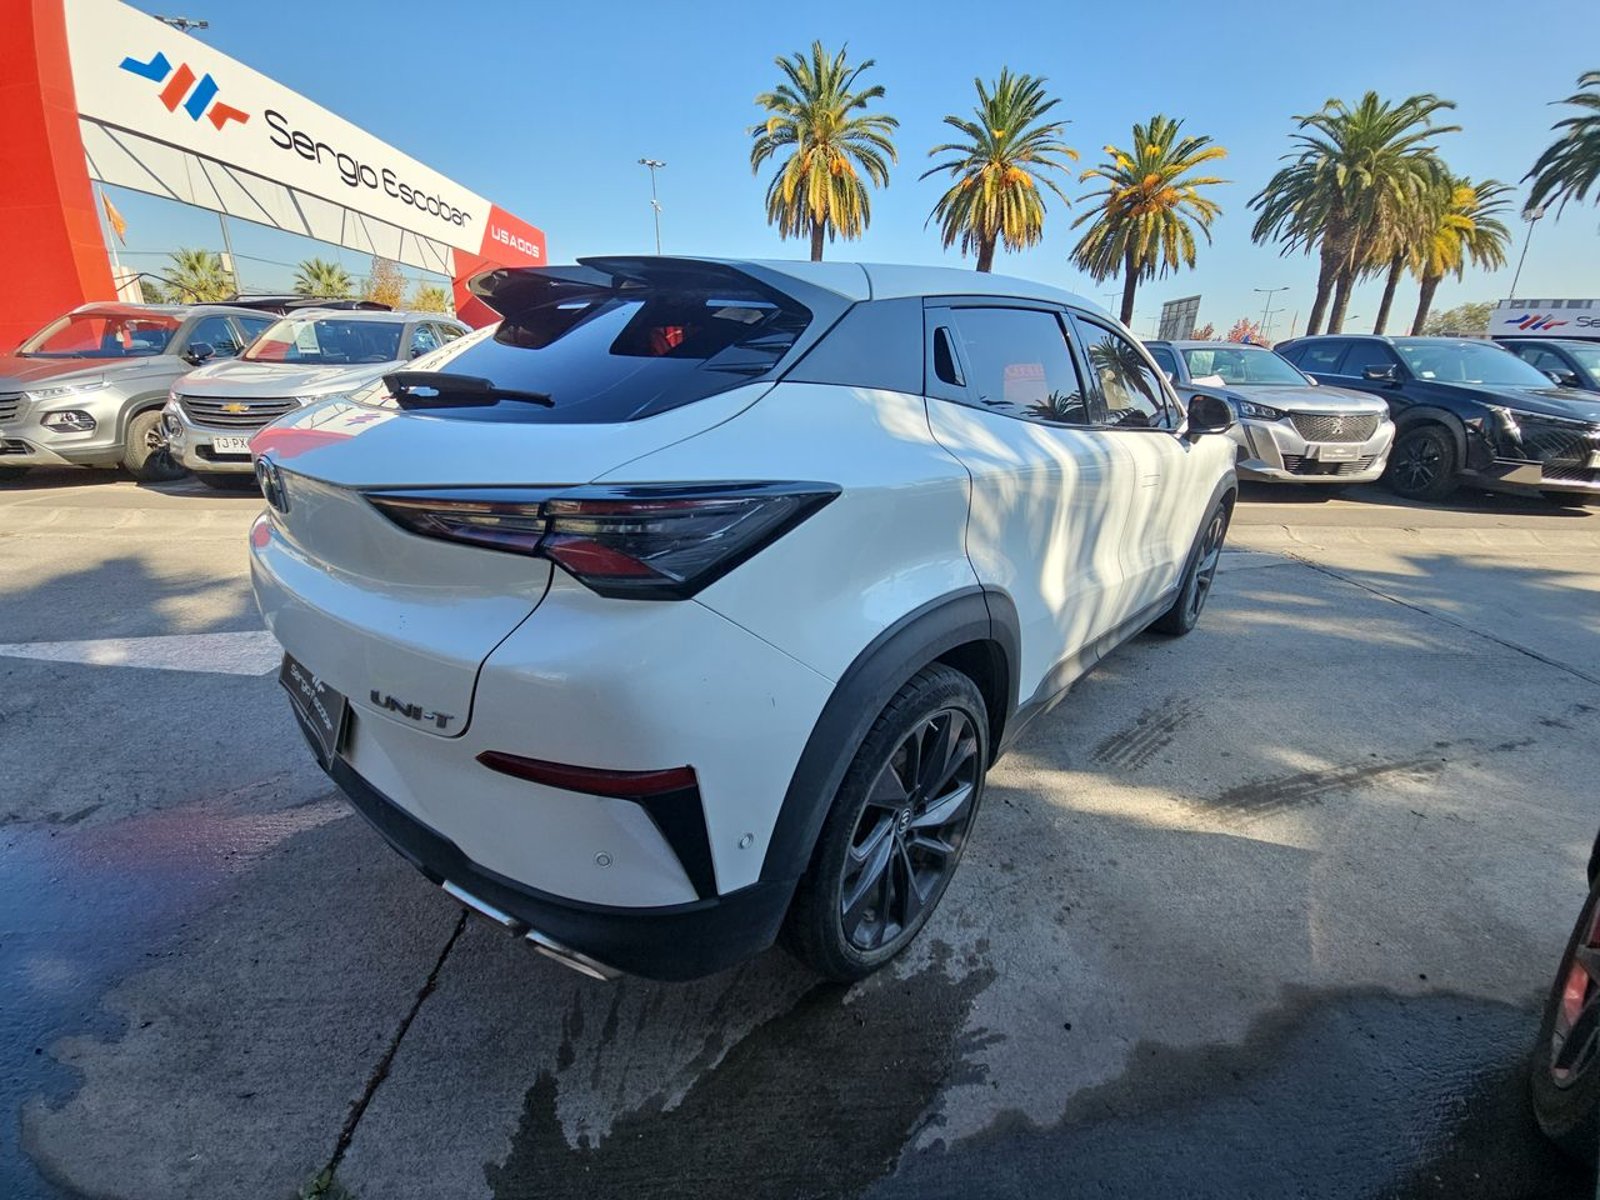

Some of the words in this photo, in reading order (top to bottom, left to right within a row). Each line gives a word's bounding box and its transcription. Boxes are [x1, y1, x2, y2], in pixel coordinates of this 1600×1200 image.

[264, 109, 378, 190] Sergio
[381, 168, 472, 227] Escobar
[491, 224, 540, 259] USADOS
[370, 689, 455, 729] UNI-T
